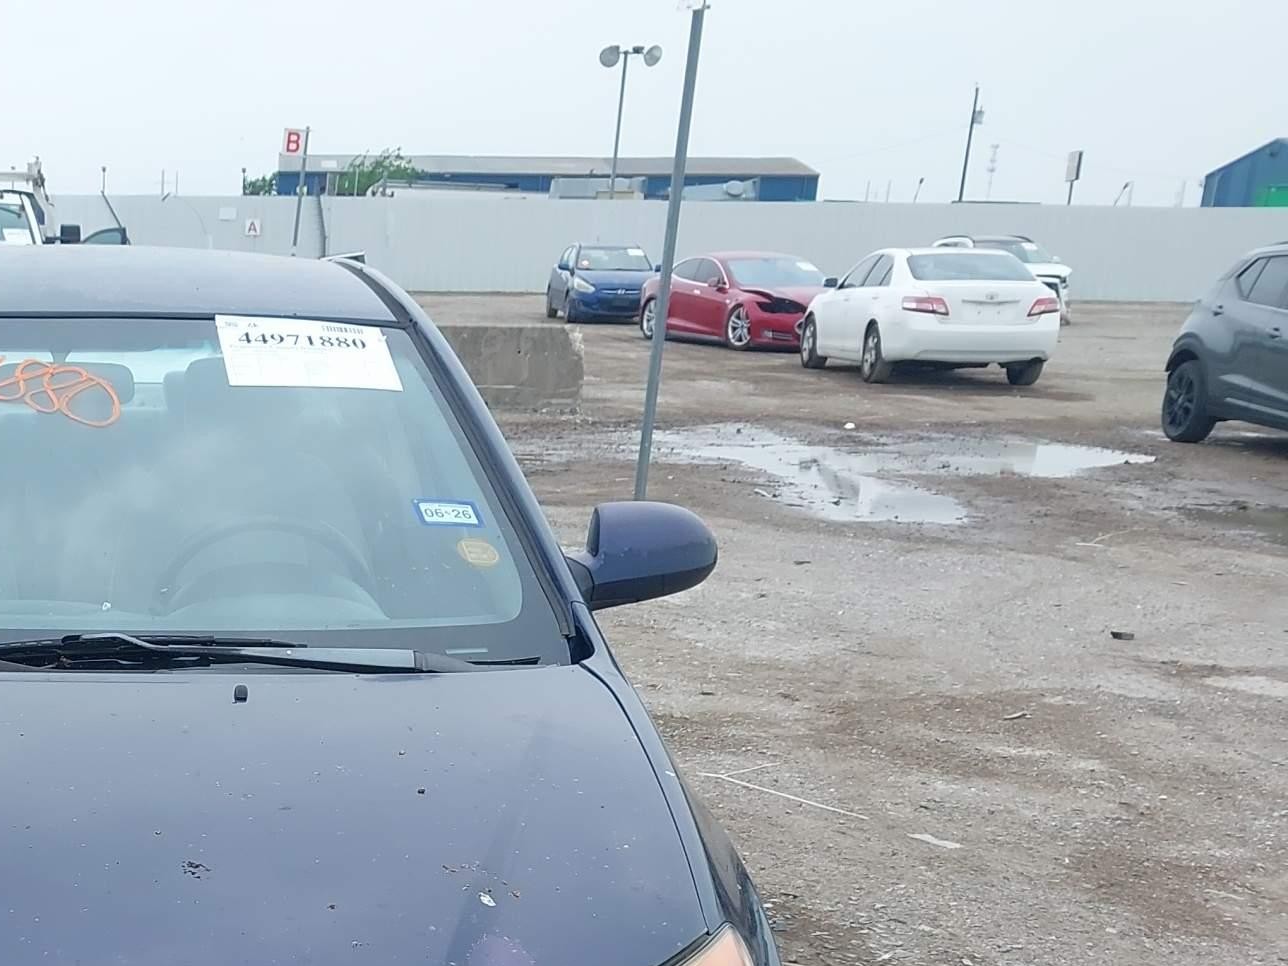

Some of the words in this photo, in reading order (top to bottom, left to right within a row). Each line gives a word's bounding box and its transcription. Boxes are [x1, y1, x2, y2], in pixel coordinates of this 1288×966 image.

[286, 131, 301, 153] B
[247, 220, 258, 234] A
[238, 331, 367, 350] 44971880
